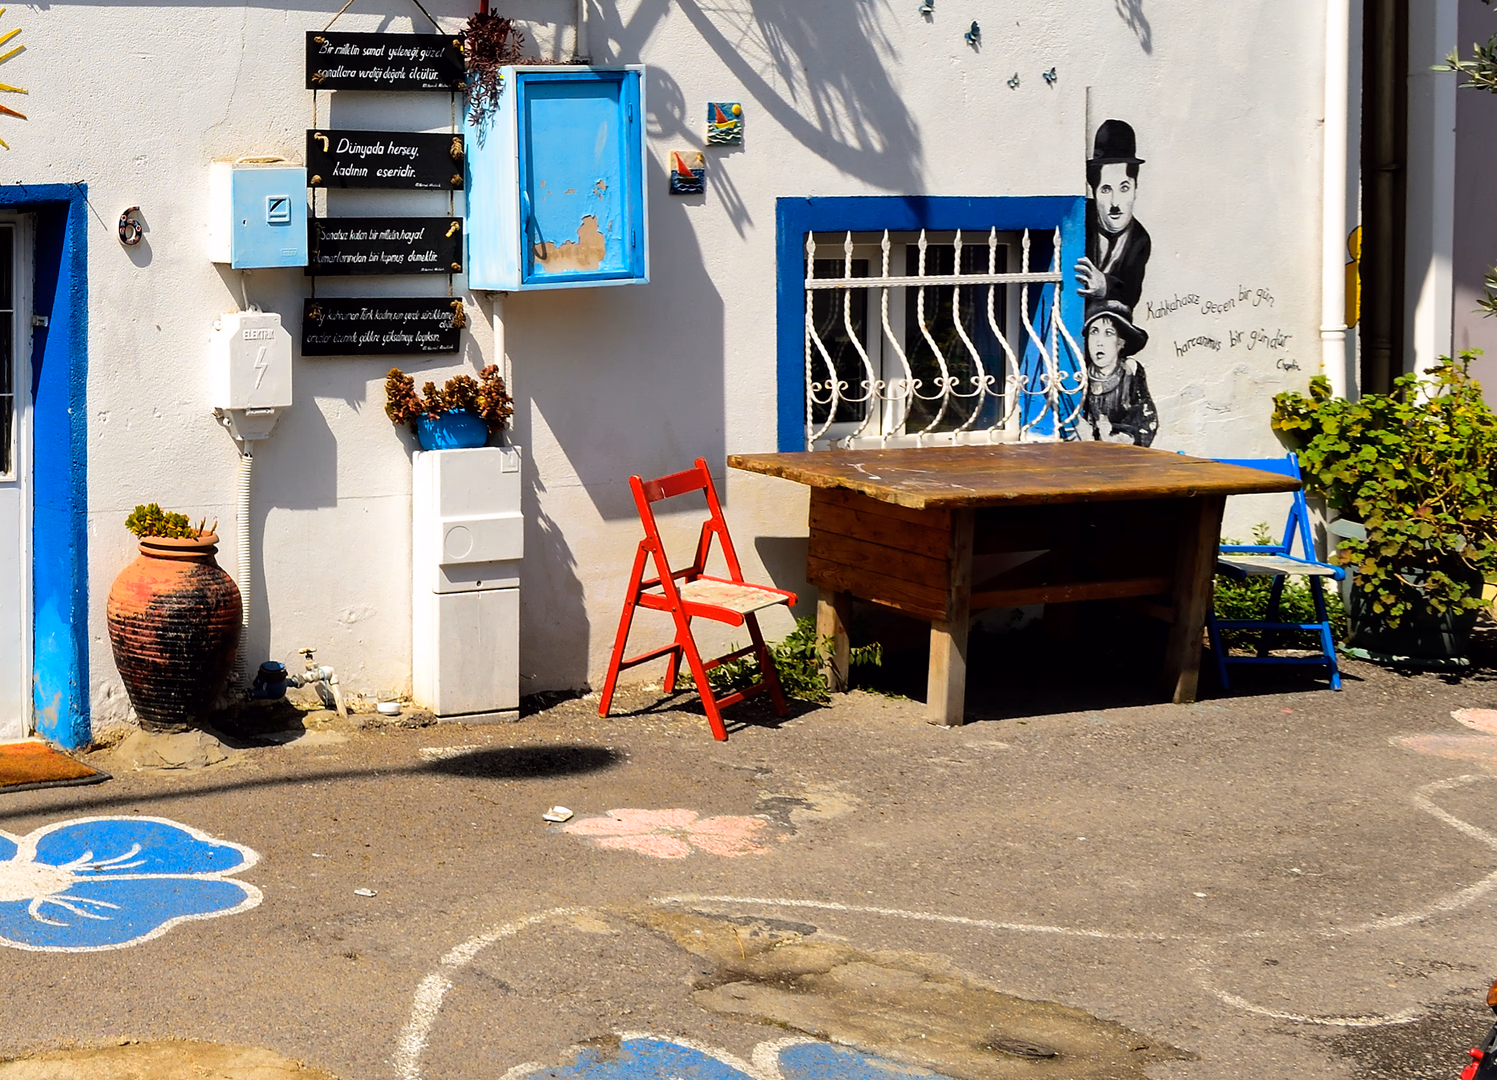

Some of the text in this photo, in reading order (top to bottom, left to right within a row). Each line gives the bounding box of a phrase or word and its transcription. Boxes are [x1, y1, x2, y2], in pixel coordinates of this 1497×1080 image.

[318, 39, 335, 55] Bir
[336, 137, 385, 159] Dünyada
[332, 161, 417, 178] kadının eseridir.
[1201, 298, 1236, 315] geçen
[1238, 284, 1253, 302] bir
[1252, 287, 1275, 308] gün
[1229, 330, 1245, 348] bir
